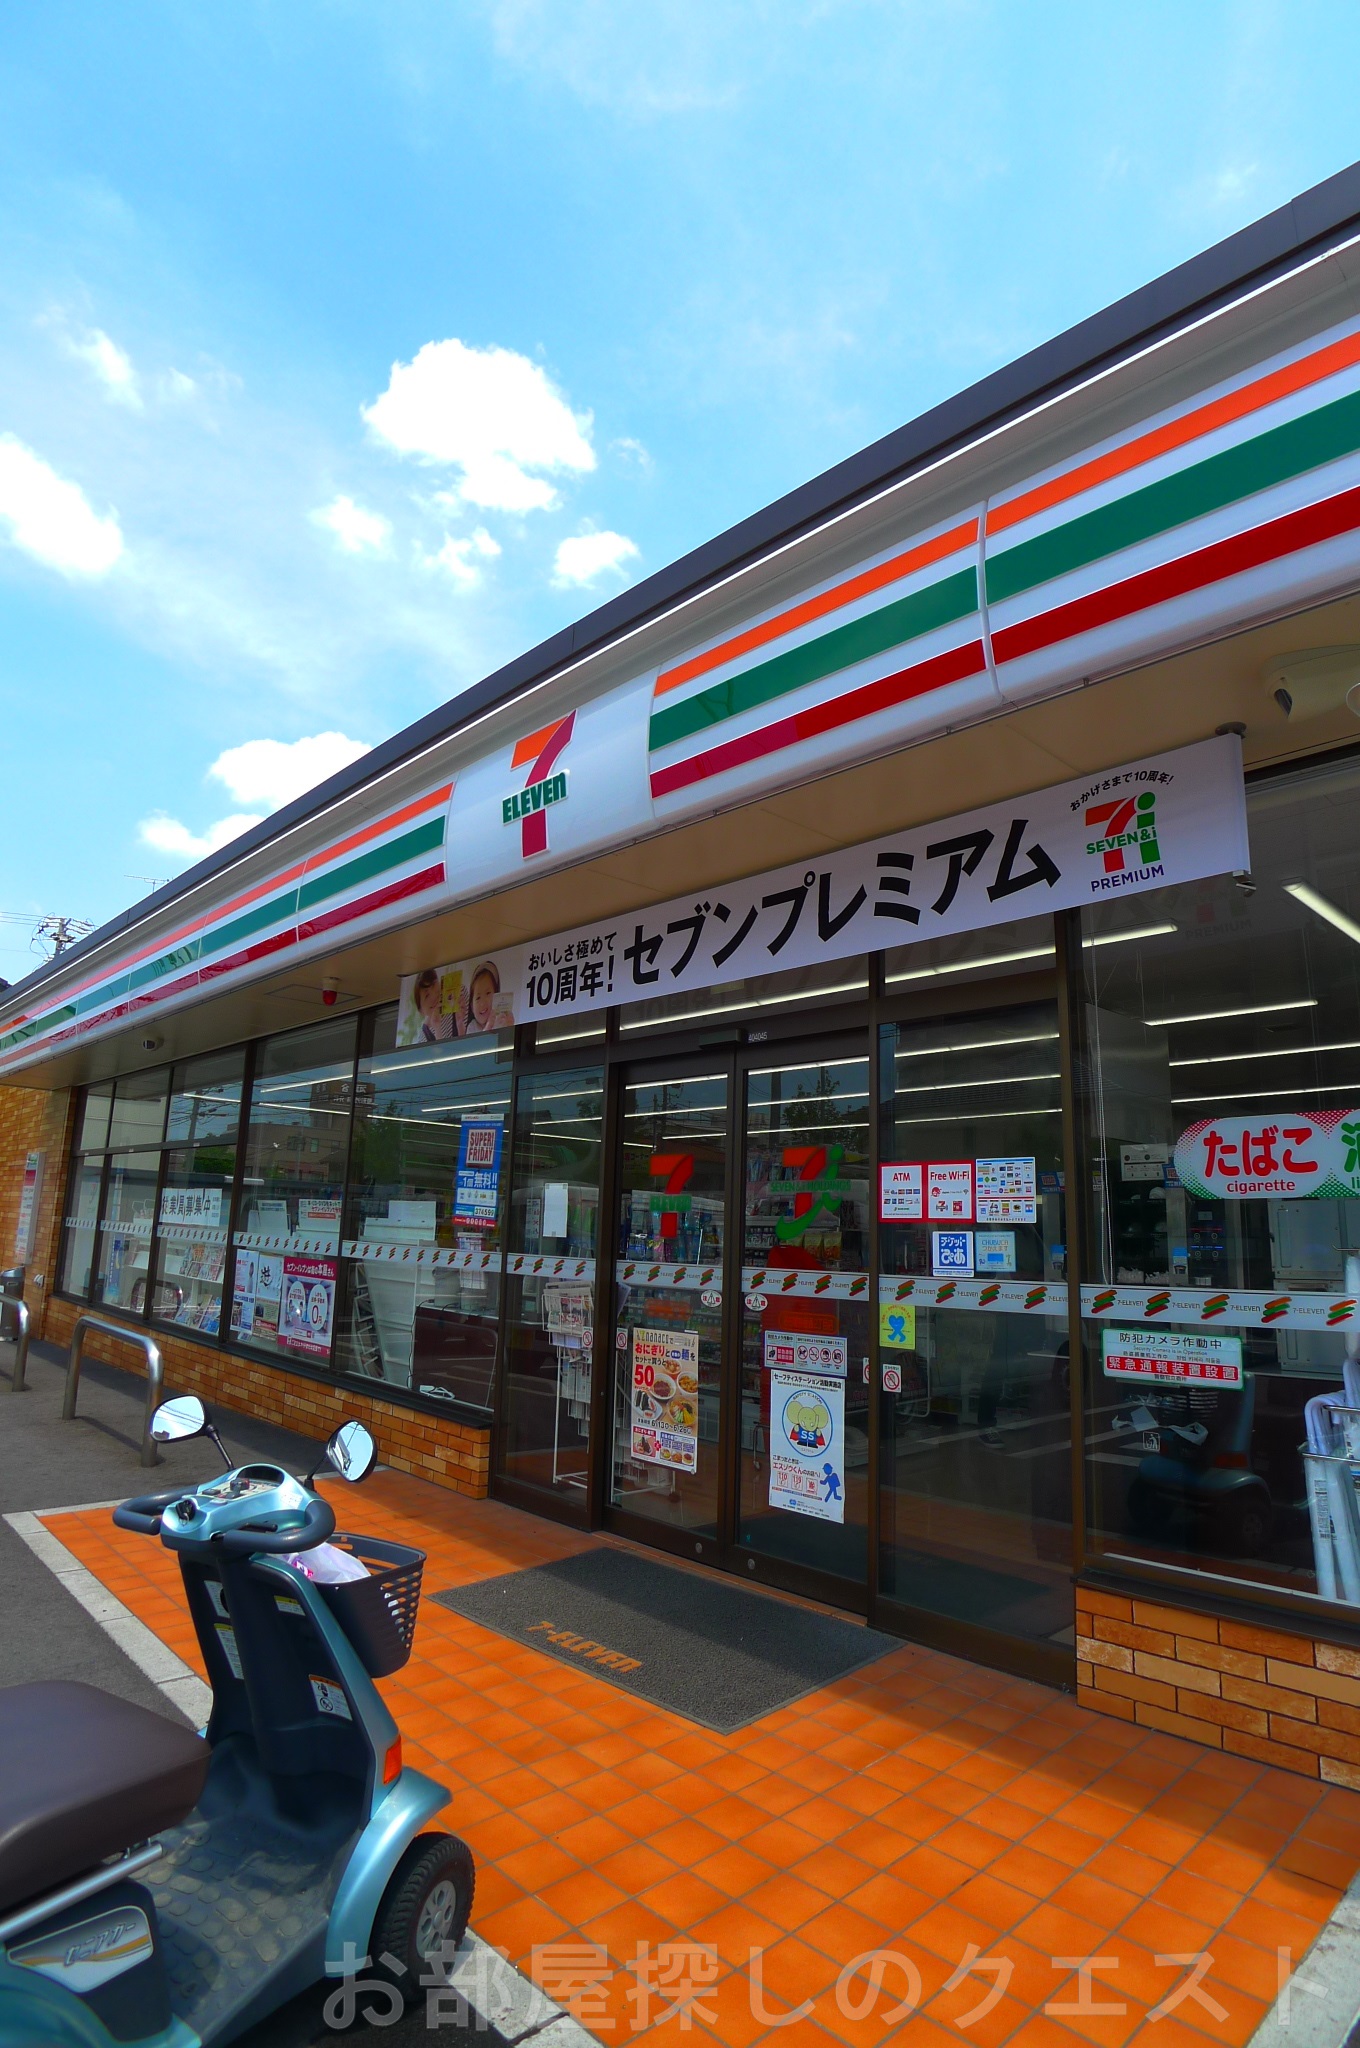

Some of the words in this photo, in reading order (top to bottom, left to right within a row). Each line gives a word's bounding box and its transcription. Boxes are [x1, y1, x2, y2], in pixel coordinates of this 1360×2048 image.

[1070, 770, 1175, 811] おかげさまで10周年!
[1091, 864, 1165, 892] PREMIUM
[623, 819, 1061, 985] セブンプレミアム
[527, 932, 617, 971] おいしさ極めて
[526, 955, 615, 1008] 10周年!
[468, 1146, 493, 1162] FRIDAY
[1203, 1124, 1318, 1178] たばこ
[892, 1172, 911, 1182] ATM
[930, 1171, 947, 1181] Free
[948, 1170, 970, 1180] Wi-Fi
[1226, 1179, 1296, 1195] cigarette
[940, 1236, 966, 1247] チケット
[940, 1247, 966, 1265] ぴあ
[1119, 1332, 1222, 1350] 防犯カメラ作動中
[1133, 1345, 1152, 1353] Security
[634, 1363, 655, 1388] 50
[1108, 1356, 1237, 1380] 緊急通報装置設置
[800, 1430, 815, 1441] SS
